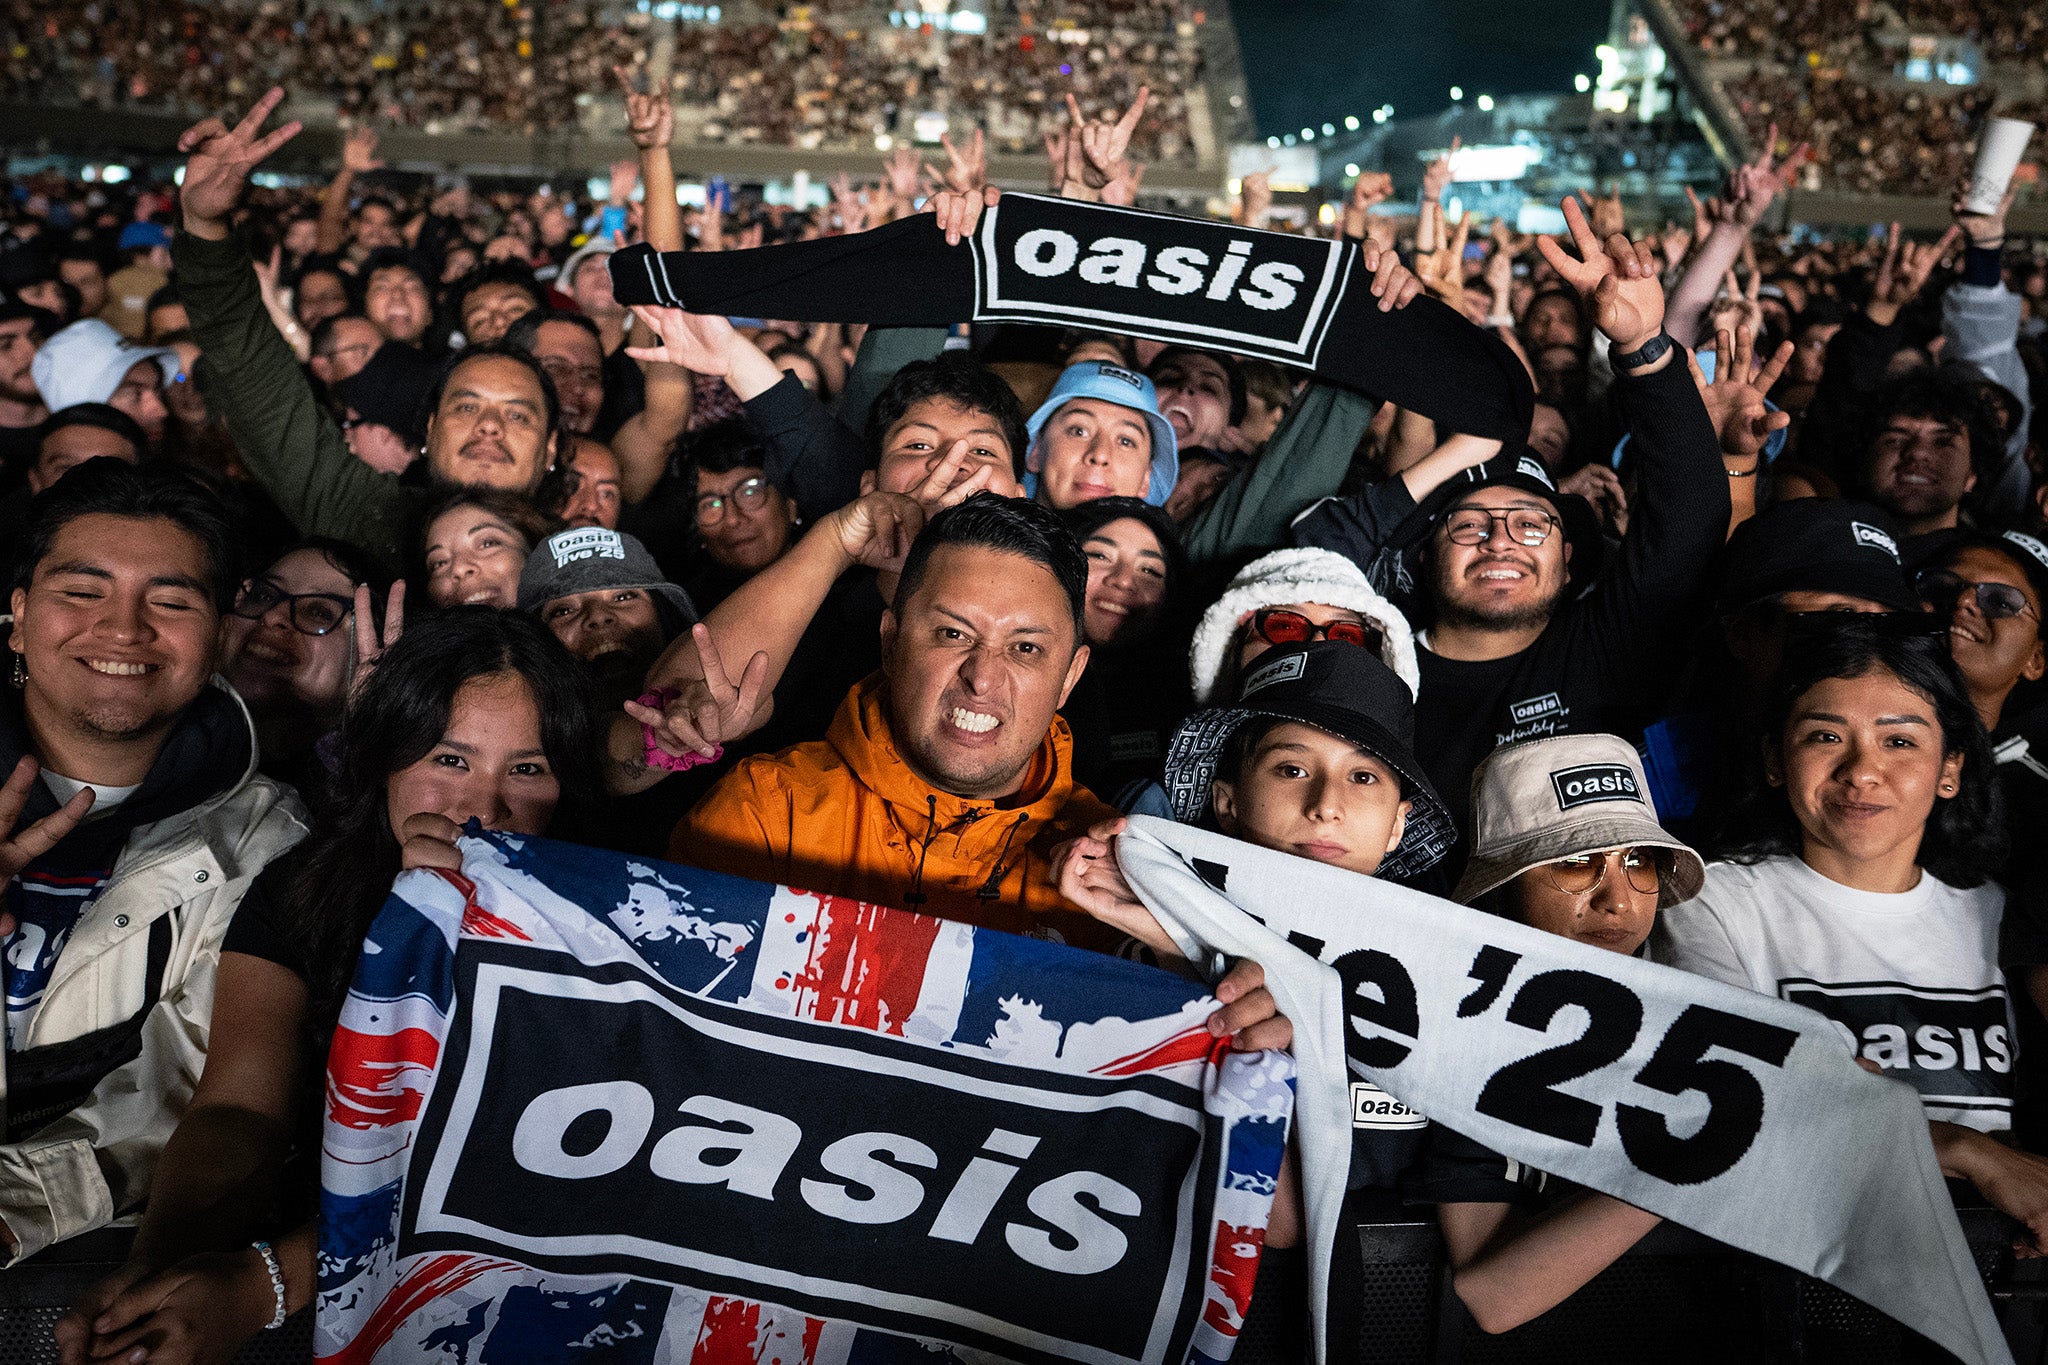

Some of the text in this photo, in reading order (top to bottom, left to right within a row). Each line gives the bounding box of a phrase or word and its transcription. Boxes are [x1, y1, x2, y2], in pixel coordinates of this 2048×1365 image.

[1014, 228, 1305, 311] oasis
[558, 532, 614, 549] oasis
[557, 545, 626, 569] live '25
[1516, 699, 1557, 718] oasis
[1565, 771, 1636, 797] oasis
[1456, 944, 1801, 1188] '25
[1360, 1100, 1420, 1116] oasi
[512, 1079, 1142, 1275] oasis
